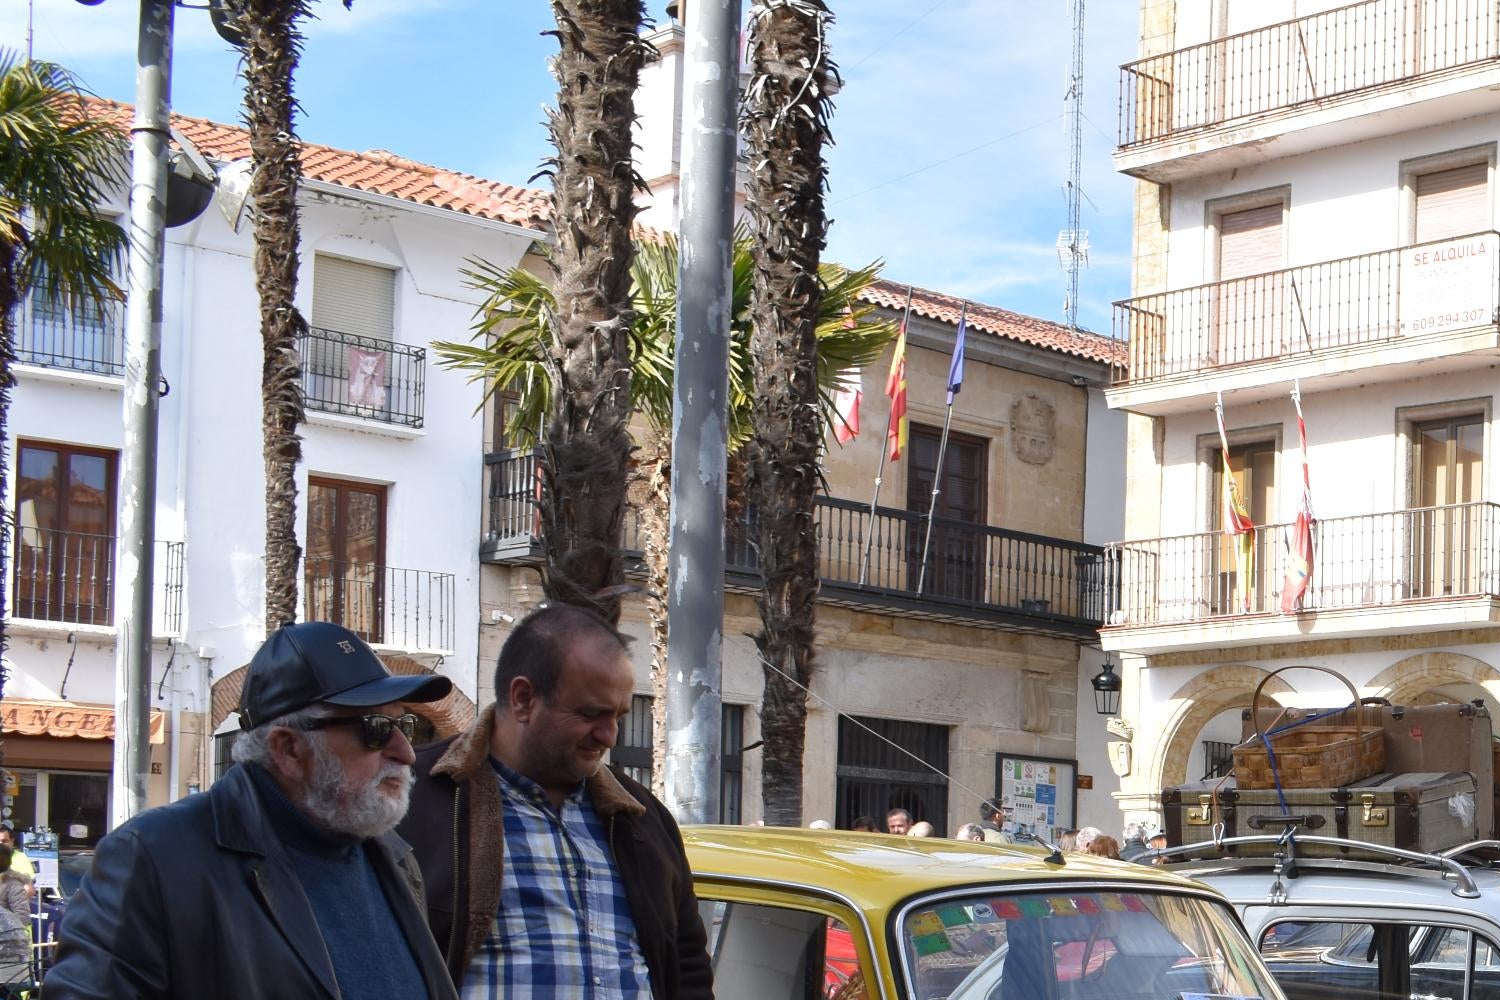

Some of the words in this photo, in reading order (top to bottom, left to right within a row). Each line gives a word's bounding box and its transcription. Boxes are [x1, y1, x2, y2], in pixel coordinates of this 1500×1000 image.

[1414, 253, 1429, 266] SE
[1433, 242, 1486, 262] ALQUILA
[1412, 317, 1434, 330] 609
[1438, 313, 1458, 326] 294
[1462, 308, 1484, 322] 307
